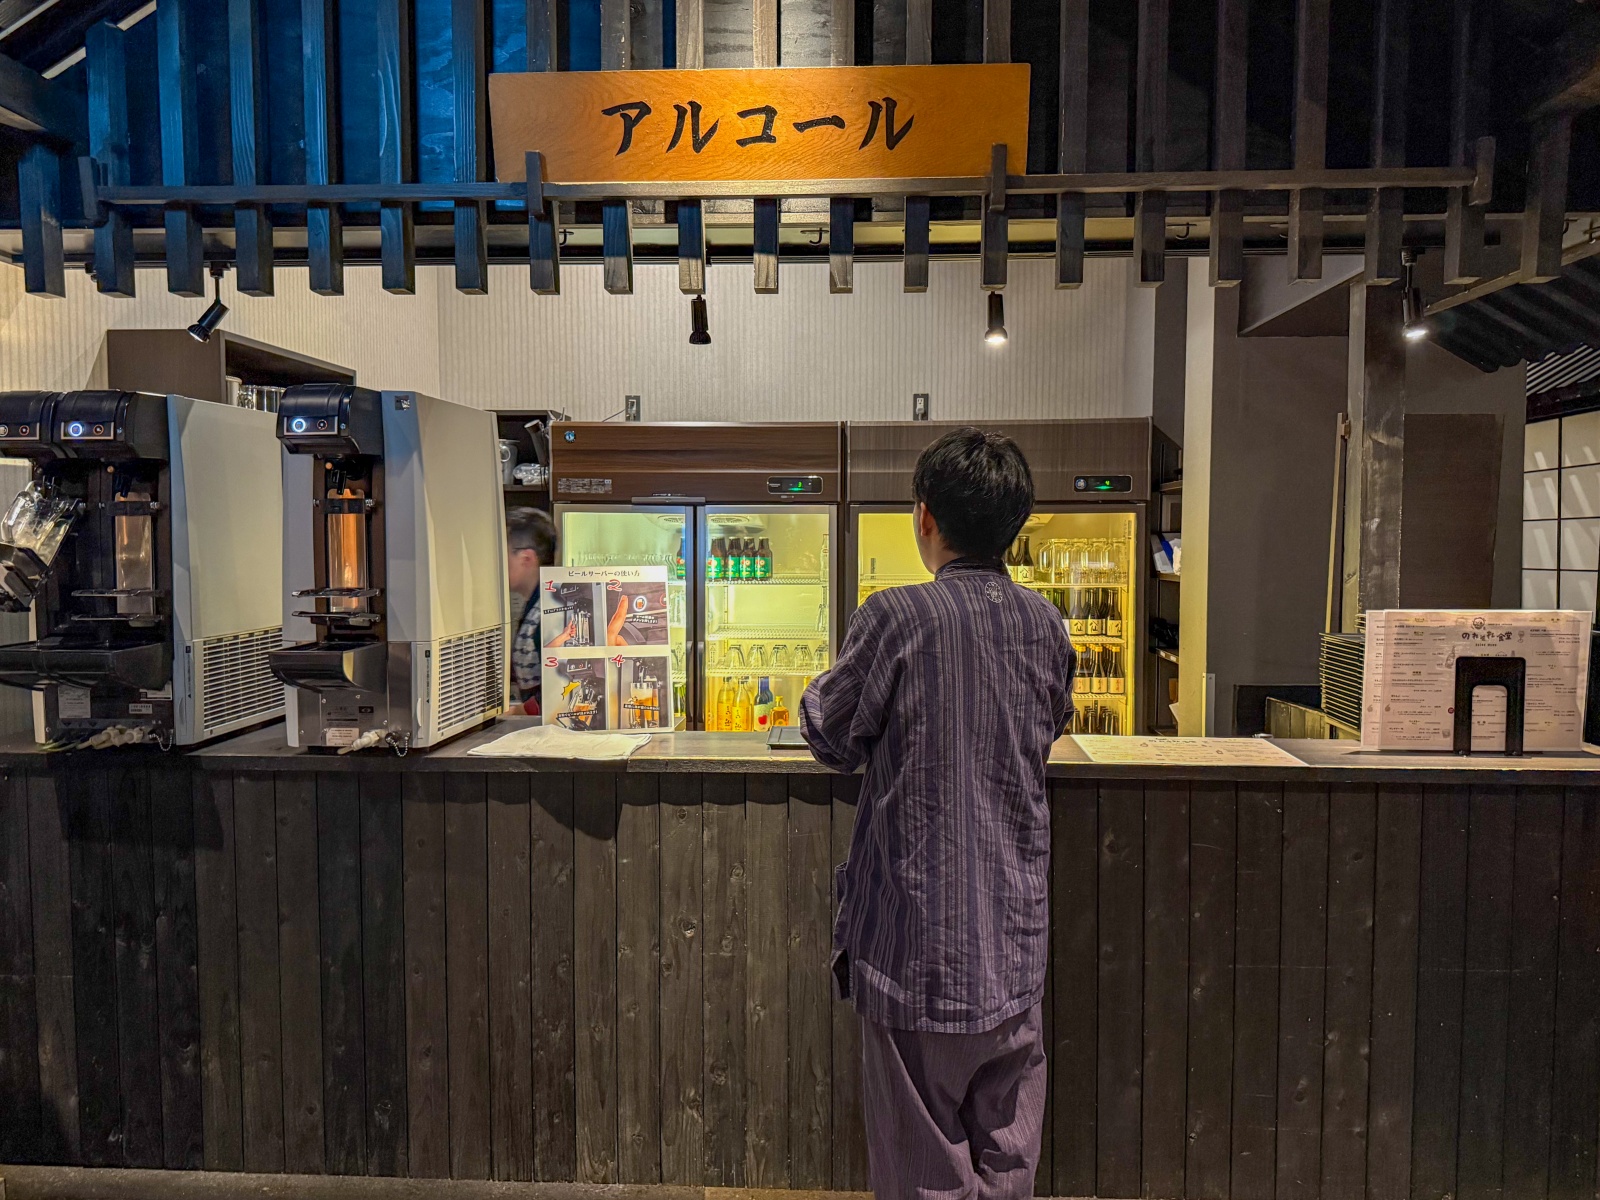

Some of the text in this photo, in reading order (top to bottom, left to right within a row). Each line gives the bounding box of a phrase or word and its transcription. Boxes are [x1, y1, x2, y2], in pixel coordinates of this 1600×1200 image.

[601, 95, 915, 156] アルコール
[544, 580, 557, 592] 1
[607, 579, 622, 591] 2
[544, 657, 558, 668] 3
[611, 654, 625, 668] 4
